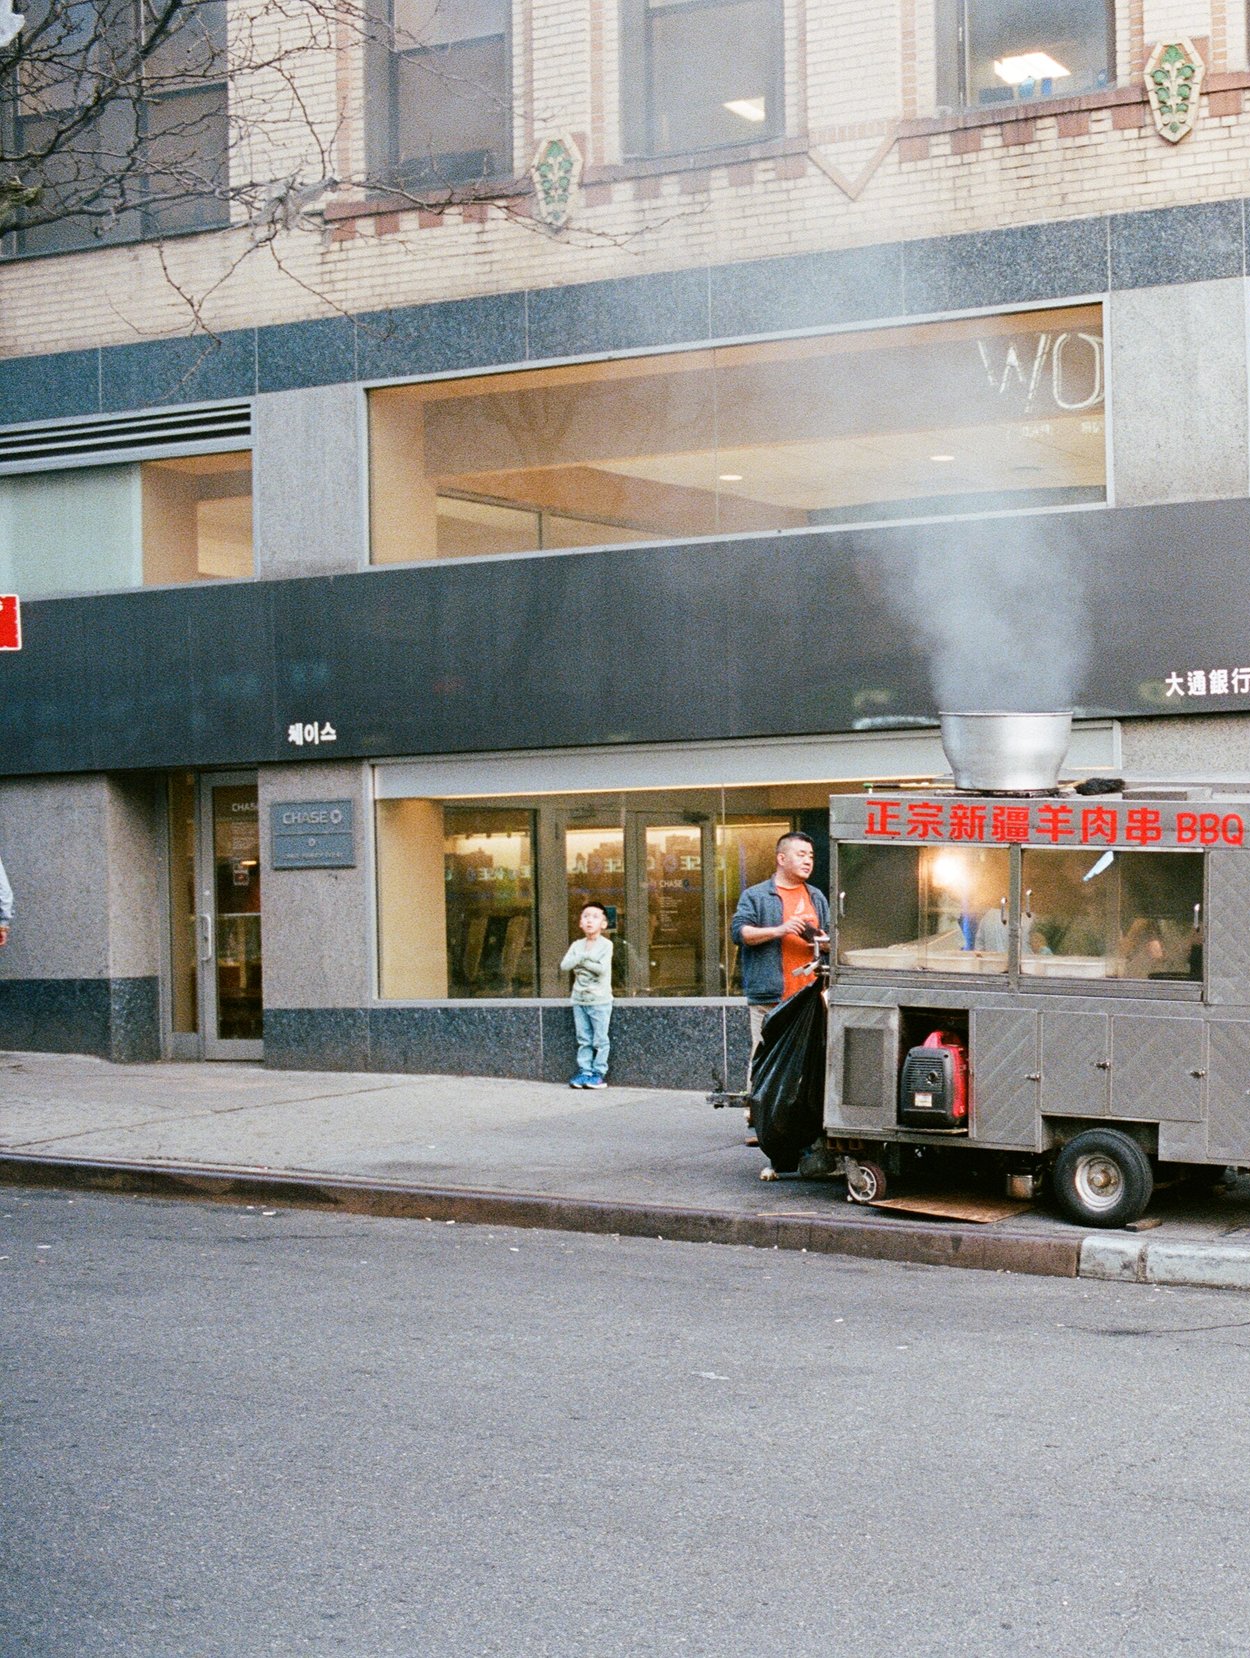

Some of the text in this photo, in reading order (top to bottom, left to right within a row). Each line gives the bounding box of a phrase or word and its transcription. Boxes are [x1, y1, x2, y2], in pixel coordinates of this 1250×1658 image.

[288, 721, 337, 746] 체이스
[232, 803, 258, 812] CHAS
[283, 811, 329, 825] CHASE
[864, 799, 1162, 846] 正宗新疆羊肉串
[1176, 812, 1244, 846] BBQ
